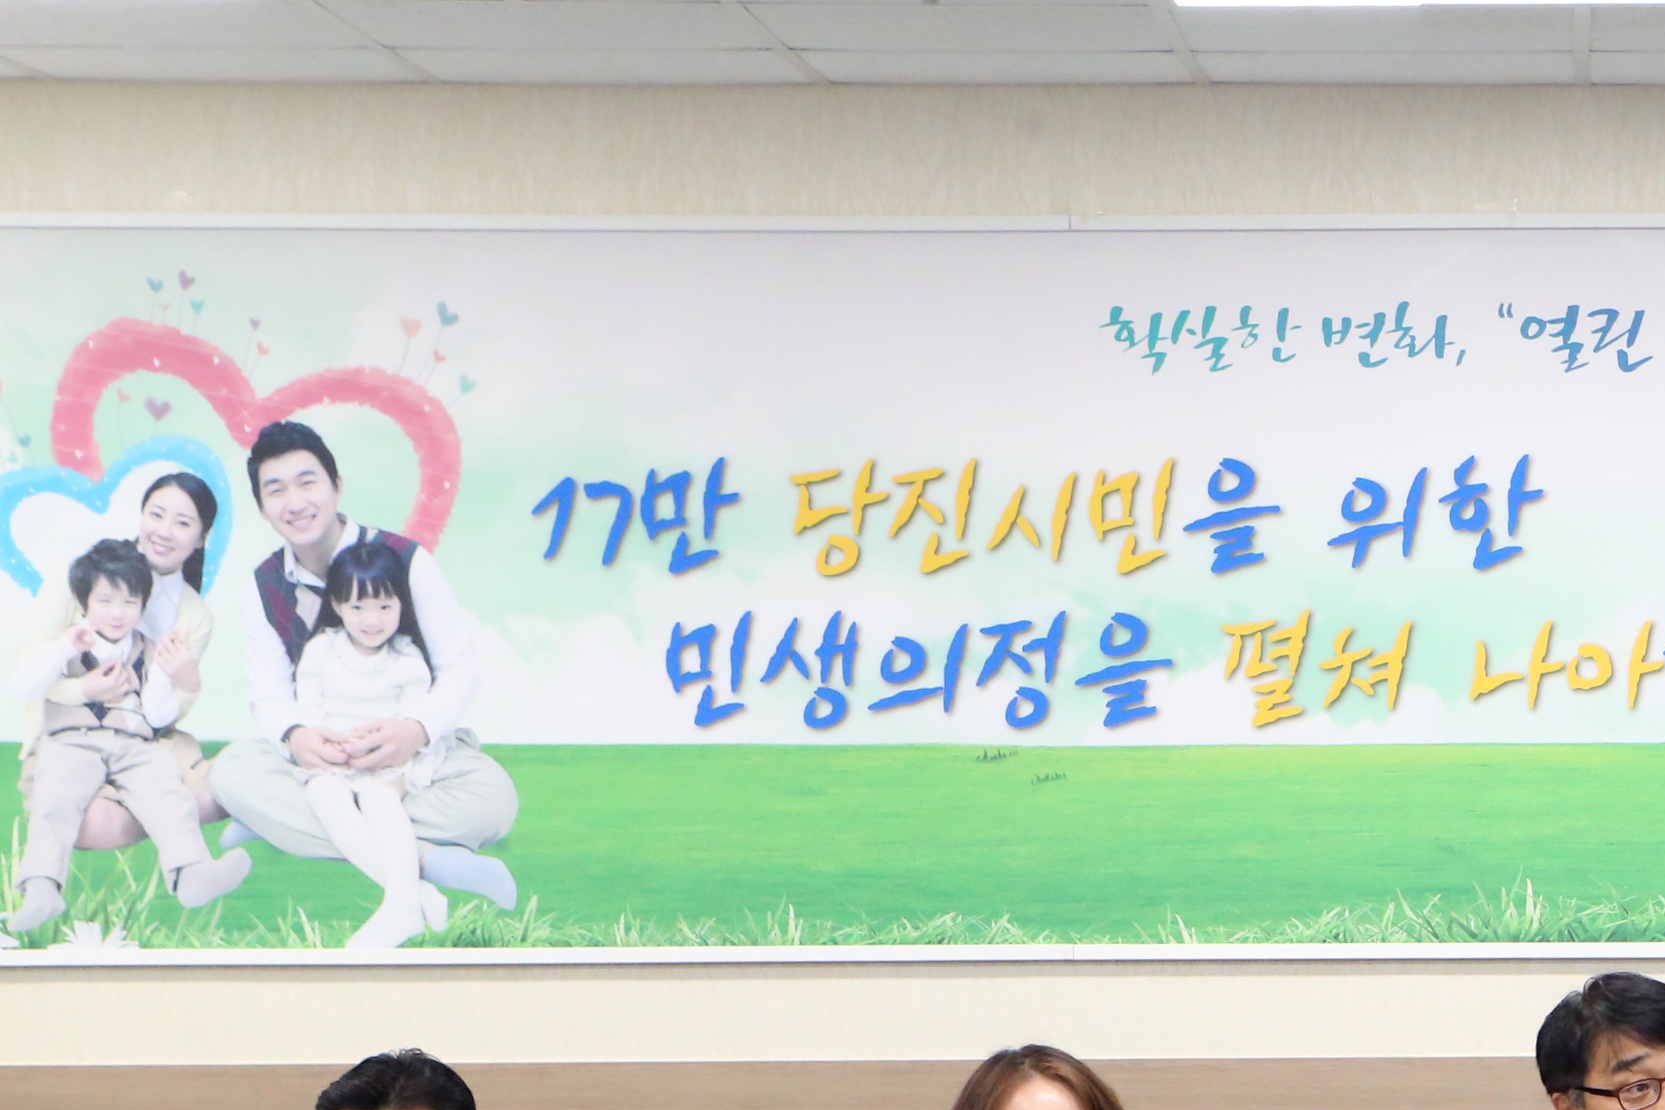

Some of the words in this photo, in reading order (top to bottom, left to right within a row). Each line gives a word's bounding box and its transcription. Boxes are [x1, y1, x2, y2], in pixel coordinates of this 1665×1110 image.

[1100, 305, 1302, 374] 확실한
[1323, 301, 1468, 368] 변화,
[533, 457, 741, 574] 17만
[790, 457, 1282, 576] 당진시민을
[1328, 455, 1545, 571] 위한
[666, 610, 1175, 729] 민생의정을
[1223, 609, 1413, 728] 펼쳐
